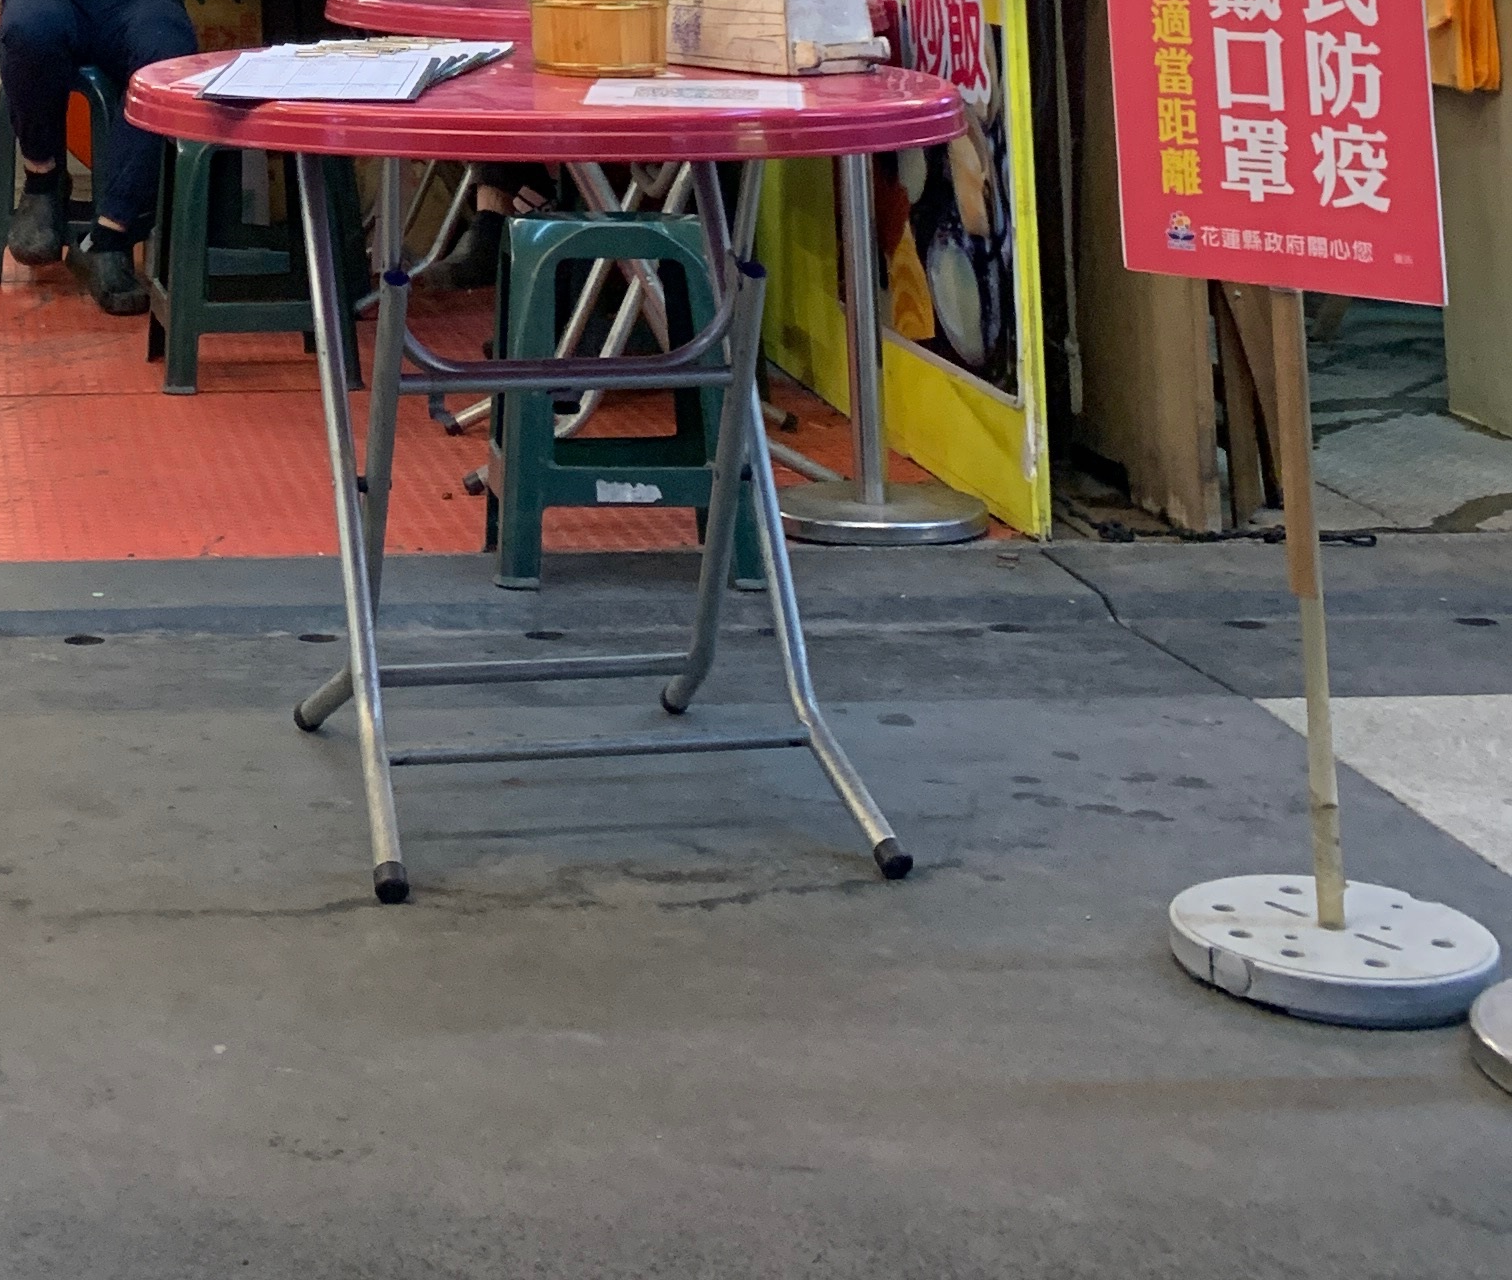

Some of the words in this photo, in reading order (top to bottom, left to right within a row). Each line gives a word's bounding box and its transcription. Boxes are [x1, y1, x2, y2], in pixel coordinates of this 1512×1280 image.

[1200, 226, 1373, 264] 花蓮縣政府關心您
